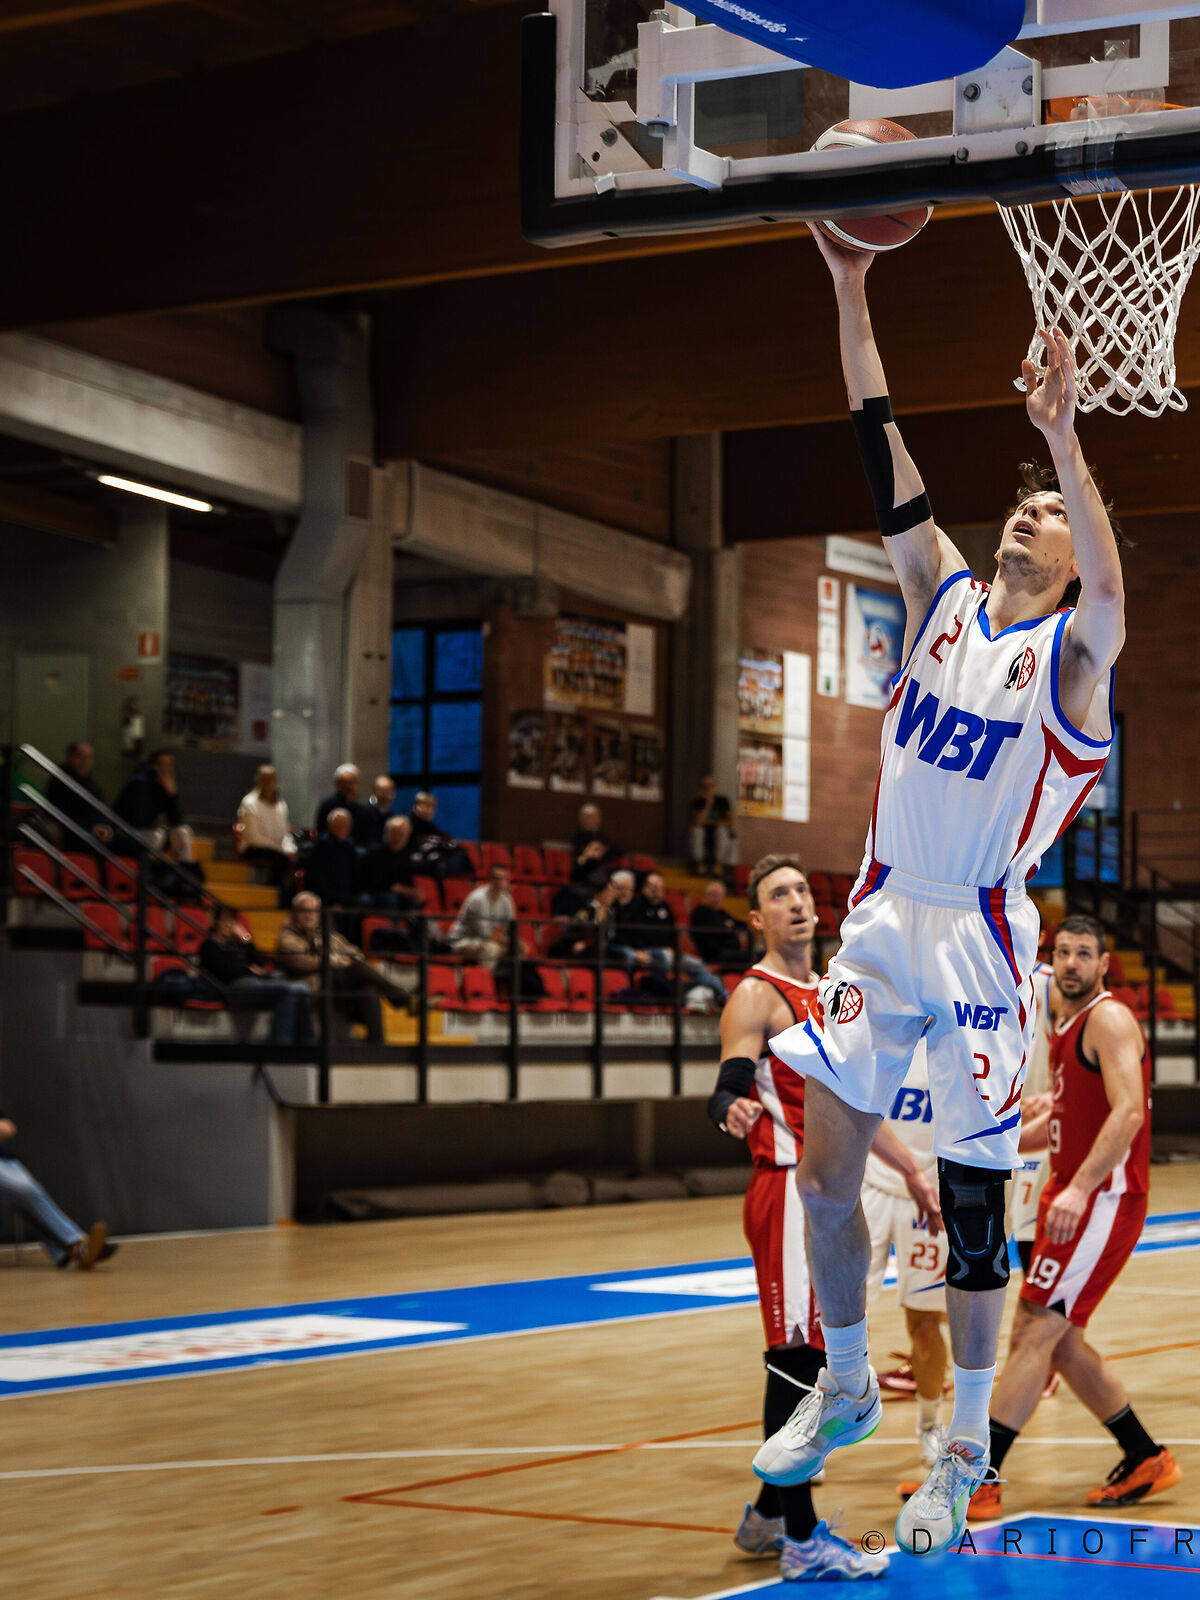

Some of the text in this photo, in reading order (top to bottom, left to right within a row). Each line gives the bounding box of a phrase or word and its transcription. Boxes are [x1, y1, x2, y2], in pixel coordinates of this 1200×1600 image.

[928, 613, 963, 664] 2
[894, 677, 1024, 782] WBT
[953, 1000, 1009, 1032] WBT
[1021, 1181, 1033, 1205] 7
[910, 1242, 940, 1272] 23
[1026, 1254, 1061, 1290] 19
